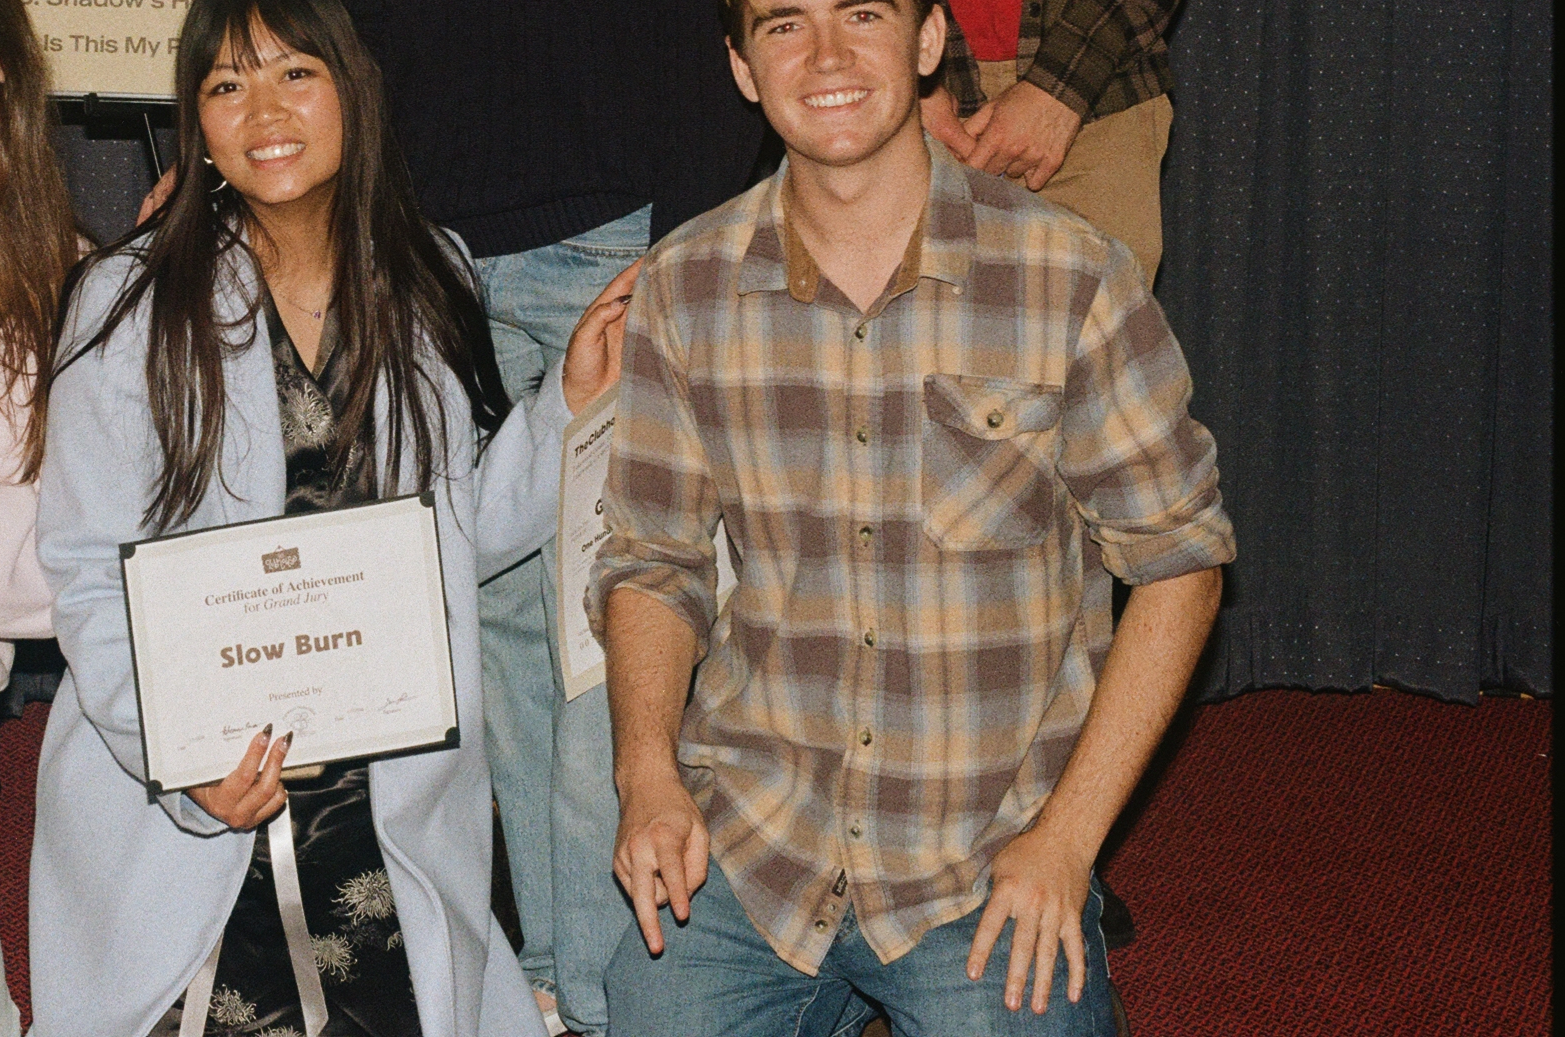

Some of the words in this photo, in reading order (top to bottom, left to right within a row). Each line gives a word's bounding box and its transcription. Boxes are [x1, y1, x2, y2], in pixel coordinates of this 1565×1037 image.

[44, 34, 63, 52] Is
[69, 34, 118, 53] This
[125, 36, 161, 58] My
[204, 587, 268, 606] Certificate
[271, 583, 284, 594] of
[286, 571, 365, 592] Achievement
[243, 602, 261, 613] for
[263, 595, 301, 611] Grand
[303, 591, 329, 605] Jury
[220, 642, 285, 668] Slow
[295, 629, 363, 656] Burn
[269, 687, 310, 702] Presented
[312, 686, 323, 697] by
